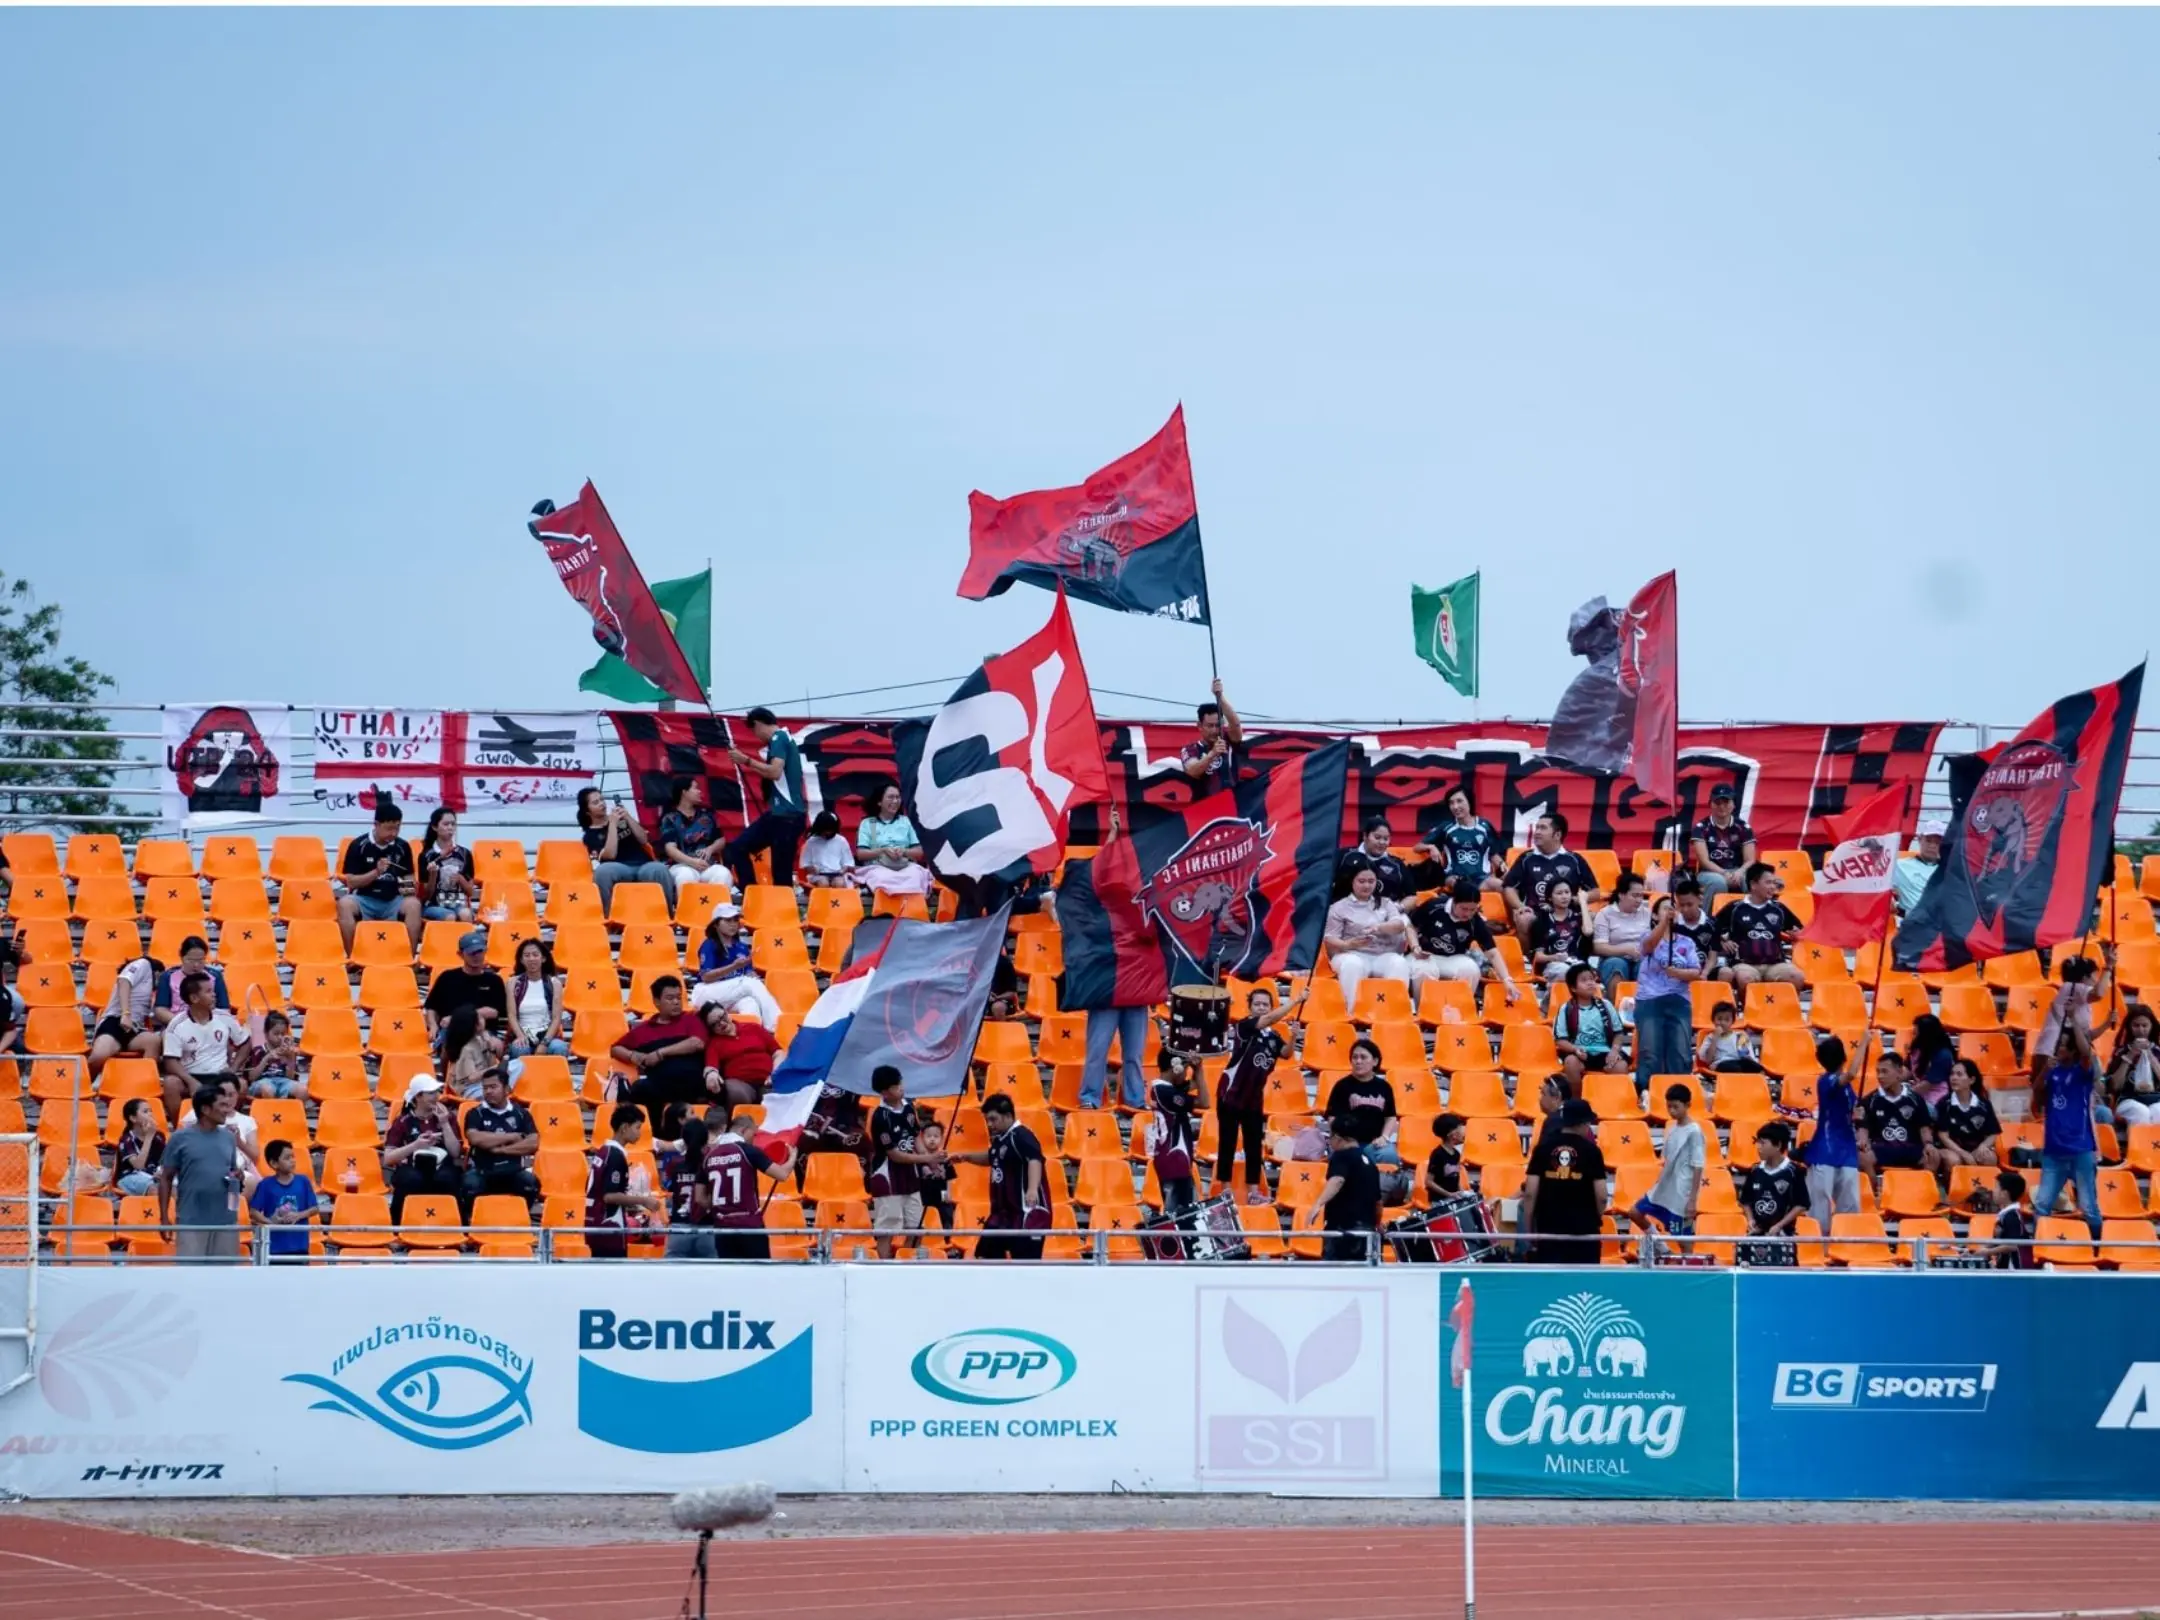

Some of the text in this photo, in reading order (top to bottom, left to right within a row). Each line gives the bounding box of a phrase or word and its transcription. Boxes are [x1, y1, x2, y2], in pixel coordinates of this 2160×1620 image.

[320, 711, 410, 737] UTHAI
[475, 753, 582, 771] away days
[708, 1167, 742, 1206] 21
[579, 1309, 776, 1350] Bendix
[332, 1315, 523, 1377] แพปลาเจ๊ทองสุข
[958, 1350, 1050, 1380] PPP
[1785, 1368, 1977, 1399] BG SPORTS
[870, 1419, 1118, 1438] PPP GREEN COMPLEX
[1485, 1385, 1686, 1459] Chang
[1243, 1419, 1344, 1466] SSI
[81, 1464, 225, 1481] オートバックス
